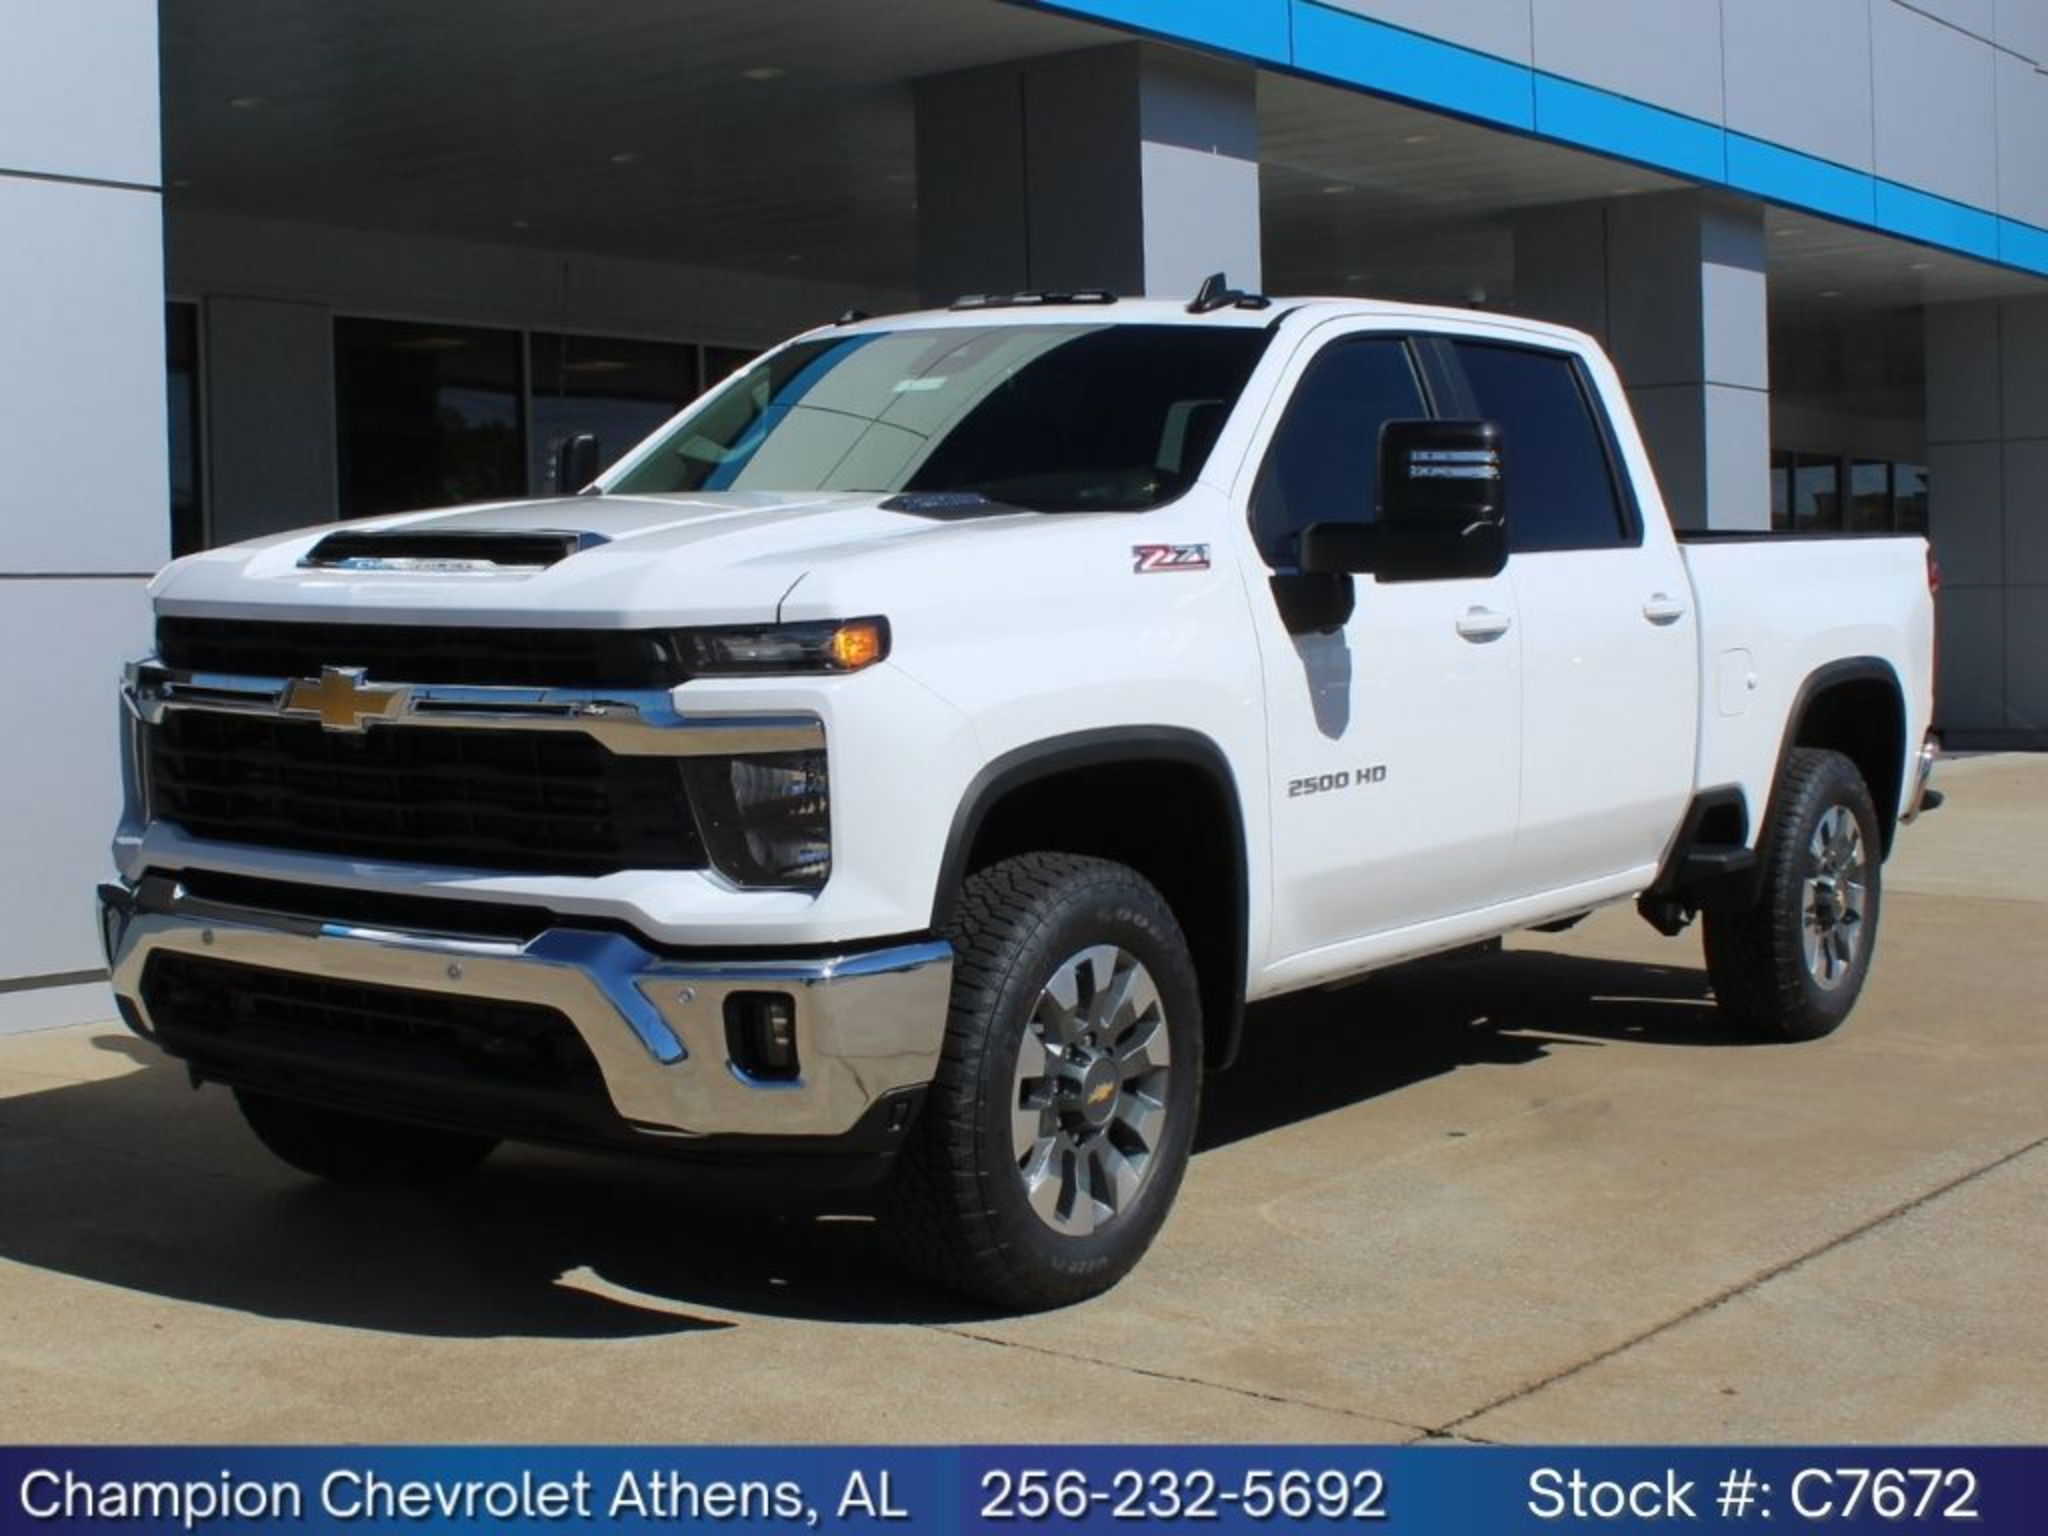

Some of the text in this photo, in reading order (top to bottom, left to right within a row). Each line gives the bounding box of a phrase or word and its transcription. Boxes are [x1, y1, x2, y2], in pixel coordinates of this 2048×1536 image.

[1132, 543, 1211, 574] Z71
[1287, 765, 1387, 798] 2500 HD
